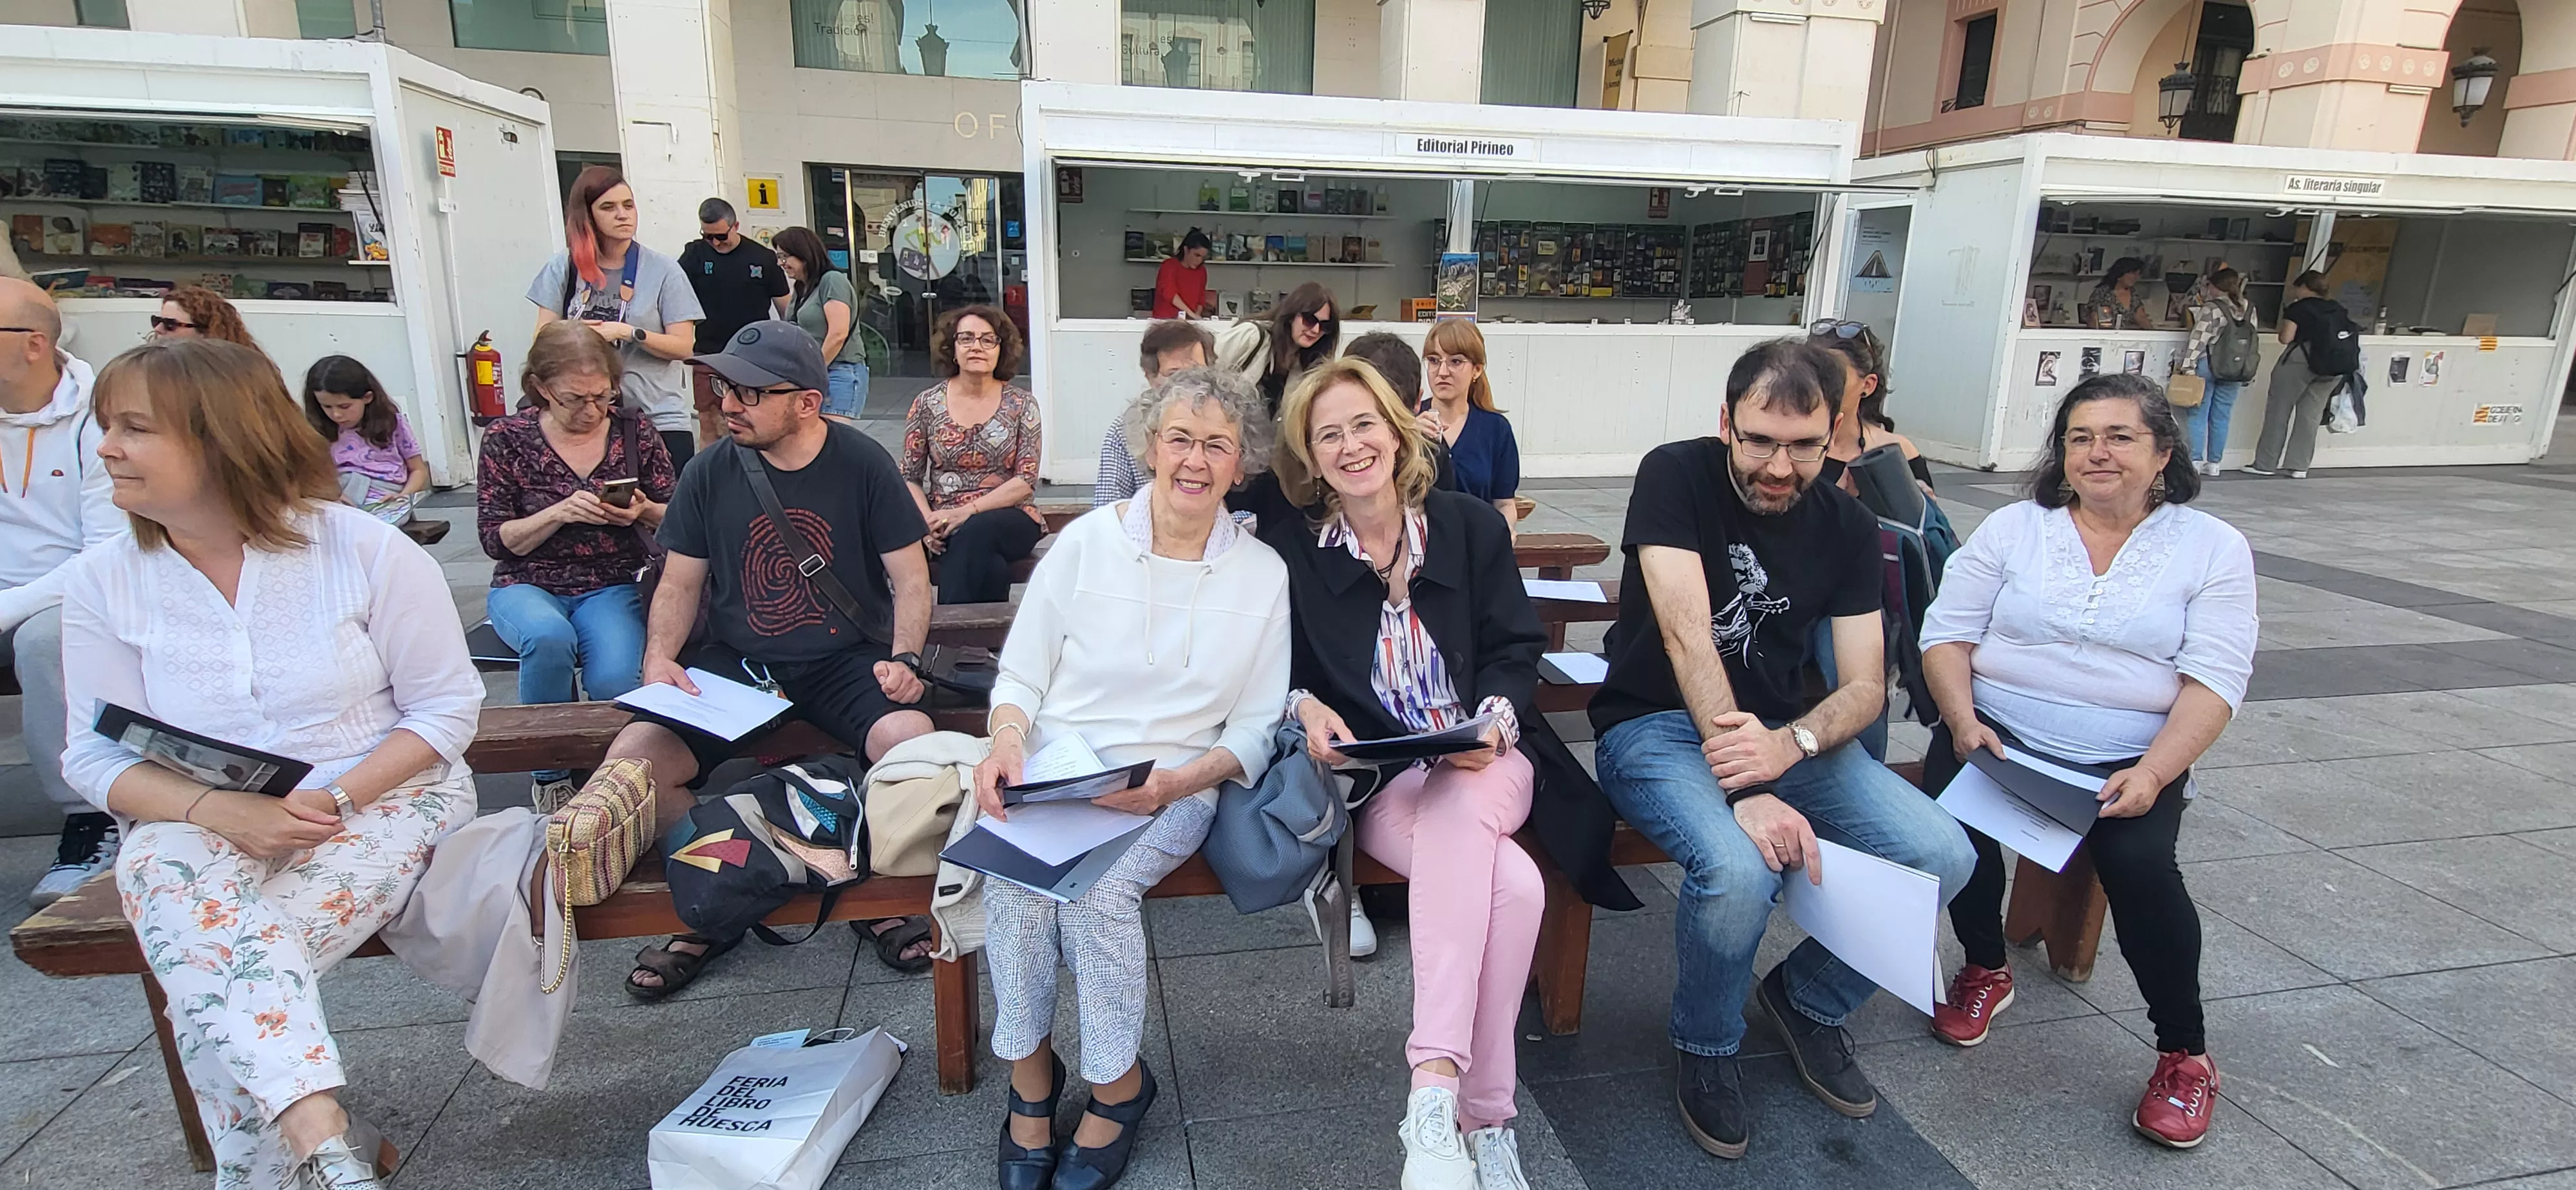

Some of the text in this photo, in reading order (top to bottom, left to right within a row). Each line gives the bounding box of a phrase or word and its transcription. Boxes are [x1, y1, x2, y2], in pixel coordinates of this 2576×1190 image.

[1417, 138, 1514, 156] Editorial Pirineo
[2287, 177, 2382, 194] As. literaria singular
[728, 1075, 789, 1088] FERIA
[715, 1085, 756, 1099] DEL
[703, 1095, 772, 1110] LIBRO
[691, 1106, 726, 1119] DE
[677, 1115, 773, 1132] HUESCA
